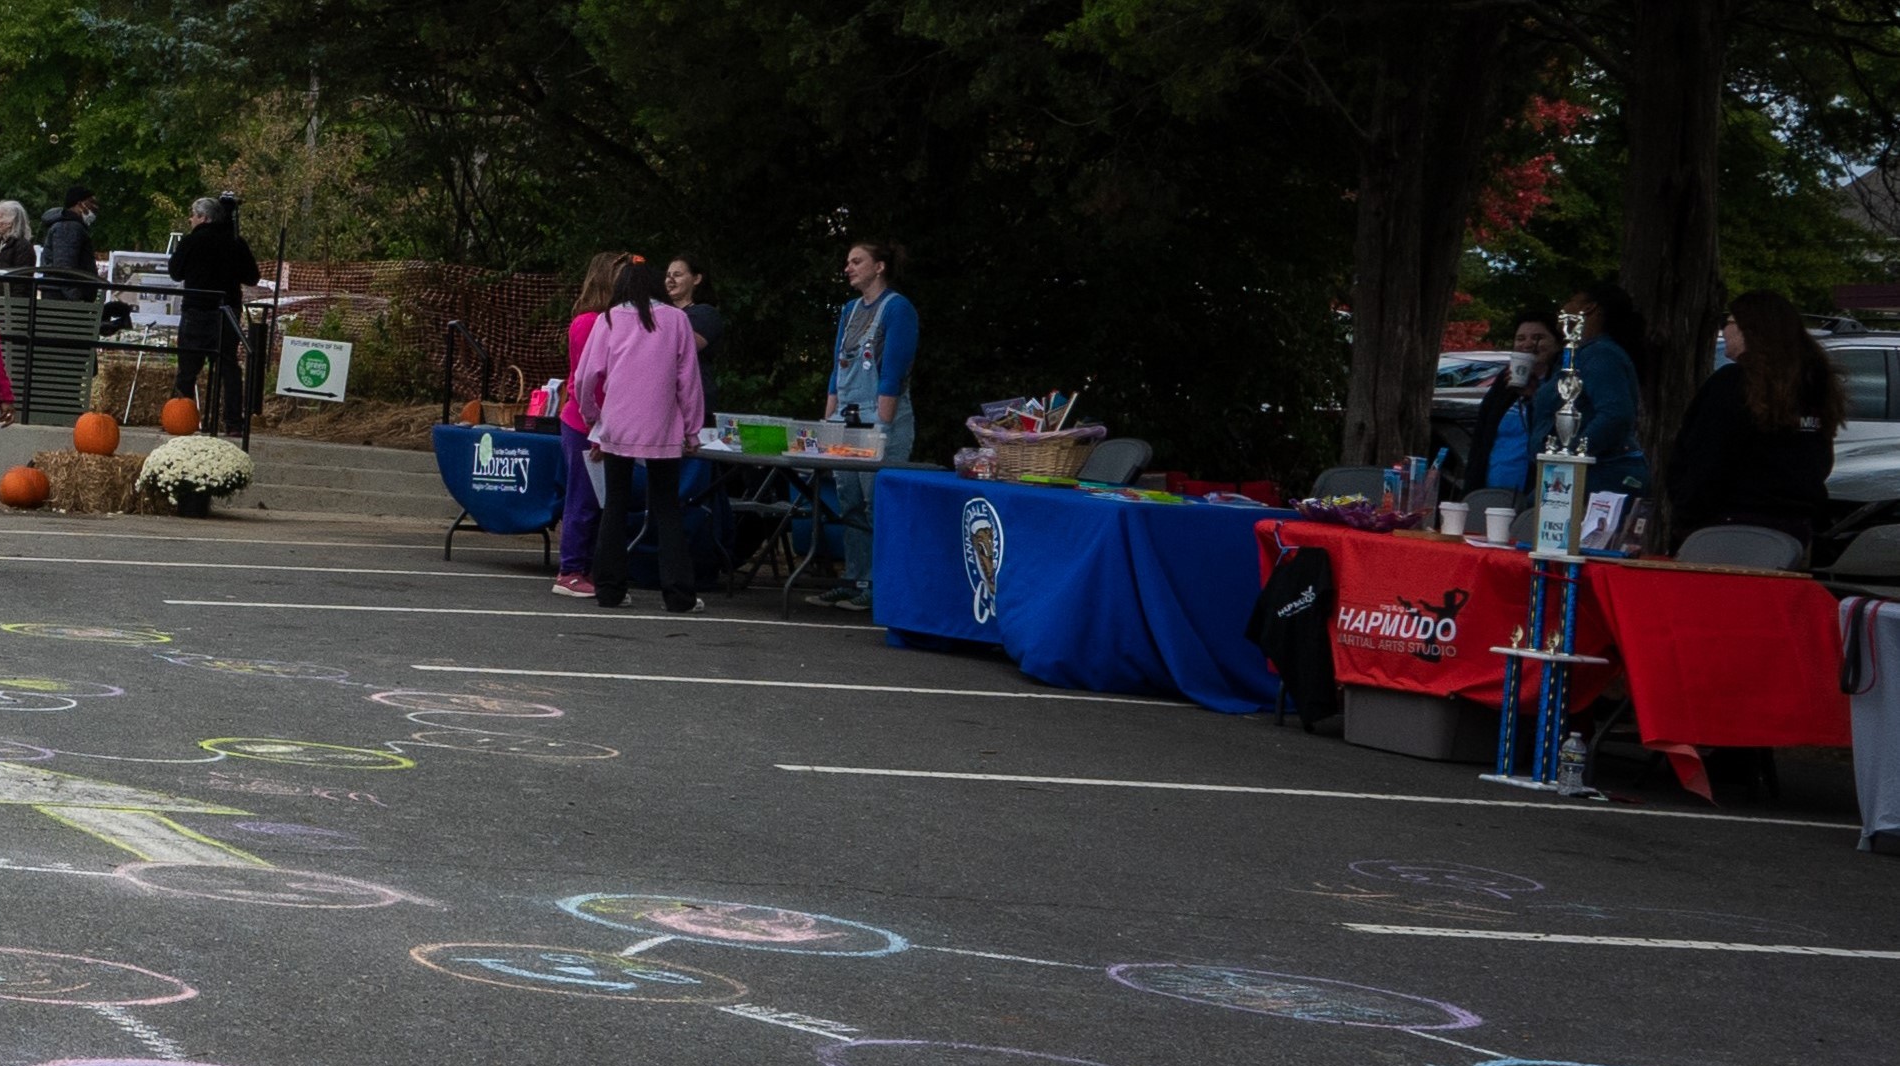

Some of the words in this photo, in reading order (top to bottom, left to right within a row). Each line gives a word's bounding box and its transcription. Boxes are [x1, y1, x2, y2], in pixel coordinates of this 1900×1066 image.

[472, 442, 531, 494] Library
[1543, 520, 1564, 532] FIRST
[1541, 532, 1564, 542] PLACE
[1336, 606, 1457, 643] HAPMUDO
[1377, 639, 1405, 653] ARTS
[1408, 641, 1457, 657] STUDIO
